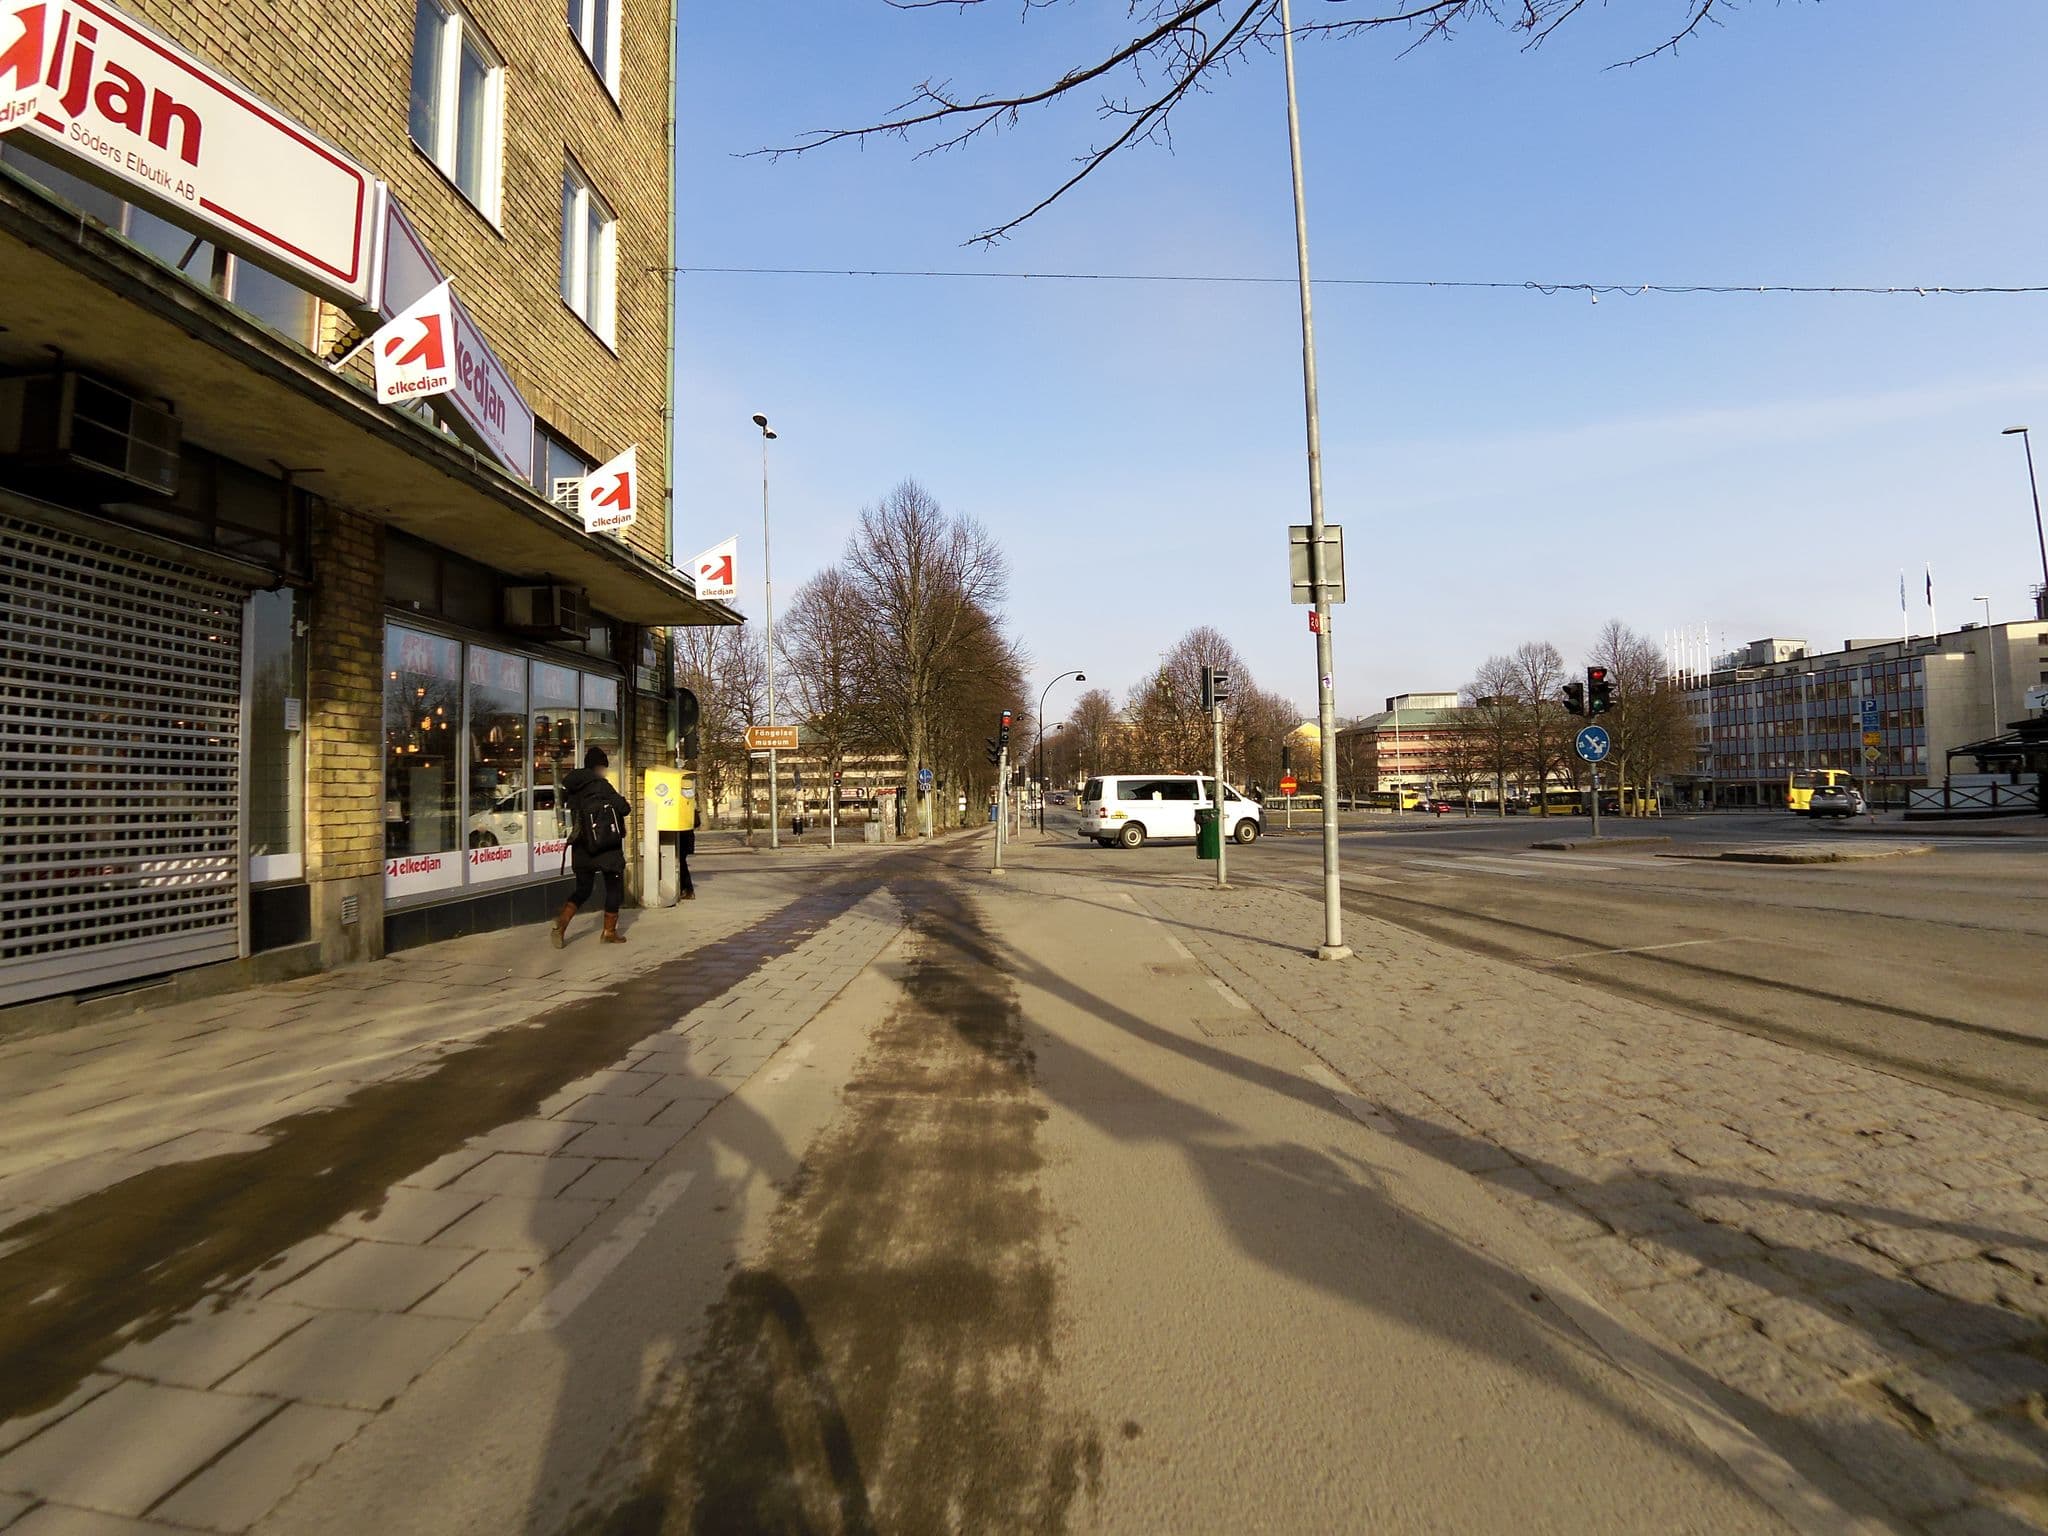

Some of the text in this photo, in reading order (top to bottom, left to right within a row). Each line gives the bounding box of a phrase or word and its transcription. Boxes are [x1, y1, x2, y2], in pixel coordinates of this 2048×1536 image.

[70, 122, 196, 201] Söders Elbutik AB
[387, 376, 448, 396] elkedjan
[592, 514, 632, 528] elkedjan
[702, 588, 734, 597] elkedjan
[1865, 700, 1874, 711] P
[479, 847, 512, 864] elkedjan
[399, 856, 441, 875] elkedjan
